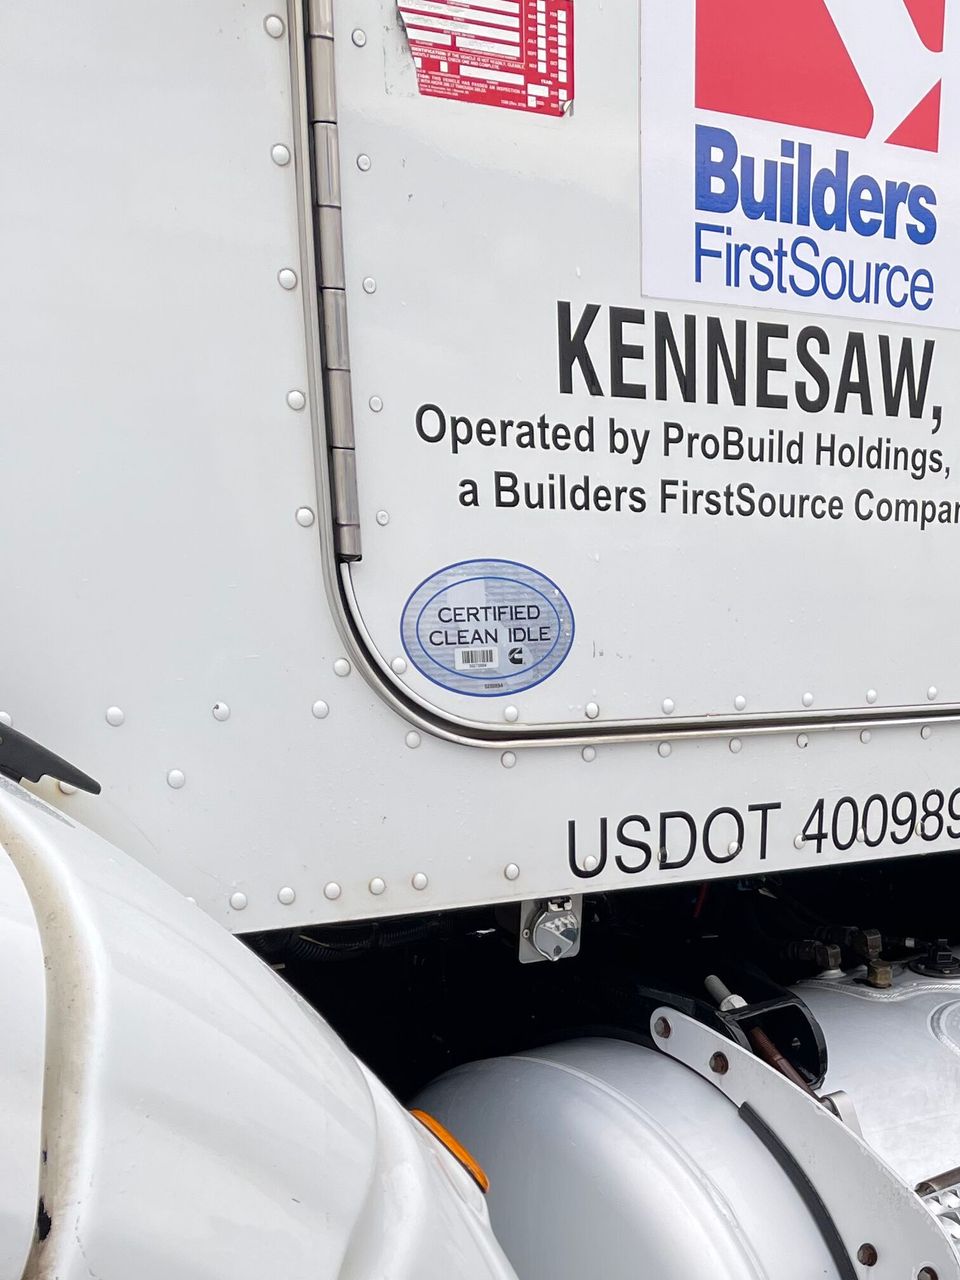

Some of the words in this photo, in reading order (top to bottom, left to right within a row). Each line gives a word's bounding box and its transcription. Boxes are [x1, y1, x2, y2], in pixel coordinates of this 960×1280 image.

[695, 124, 937, 245] Builders
[695, 222, 934, 311] FirstSource
[557, 300, 942, 434] KENNESAW,
[415, 403, 594, 454] Operated
[609, 417, 650, 464] by
[663, 421, 804, 464] ProBuild
[816, 432, 950, 480] Holdings,
[458, 478, 479, 506] a
[494, 471, 647, 513] Builders
[660, 479, 844, 520] FirstSource
[429, 628, 498, 646] CLEAN
[508, 626, 551, 643] IDLE
[438, 605, 540, 623] CERTIFIED
[568, 801, 781, 878] USDOT
